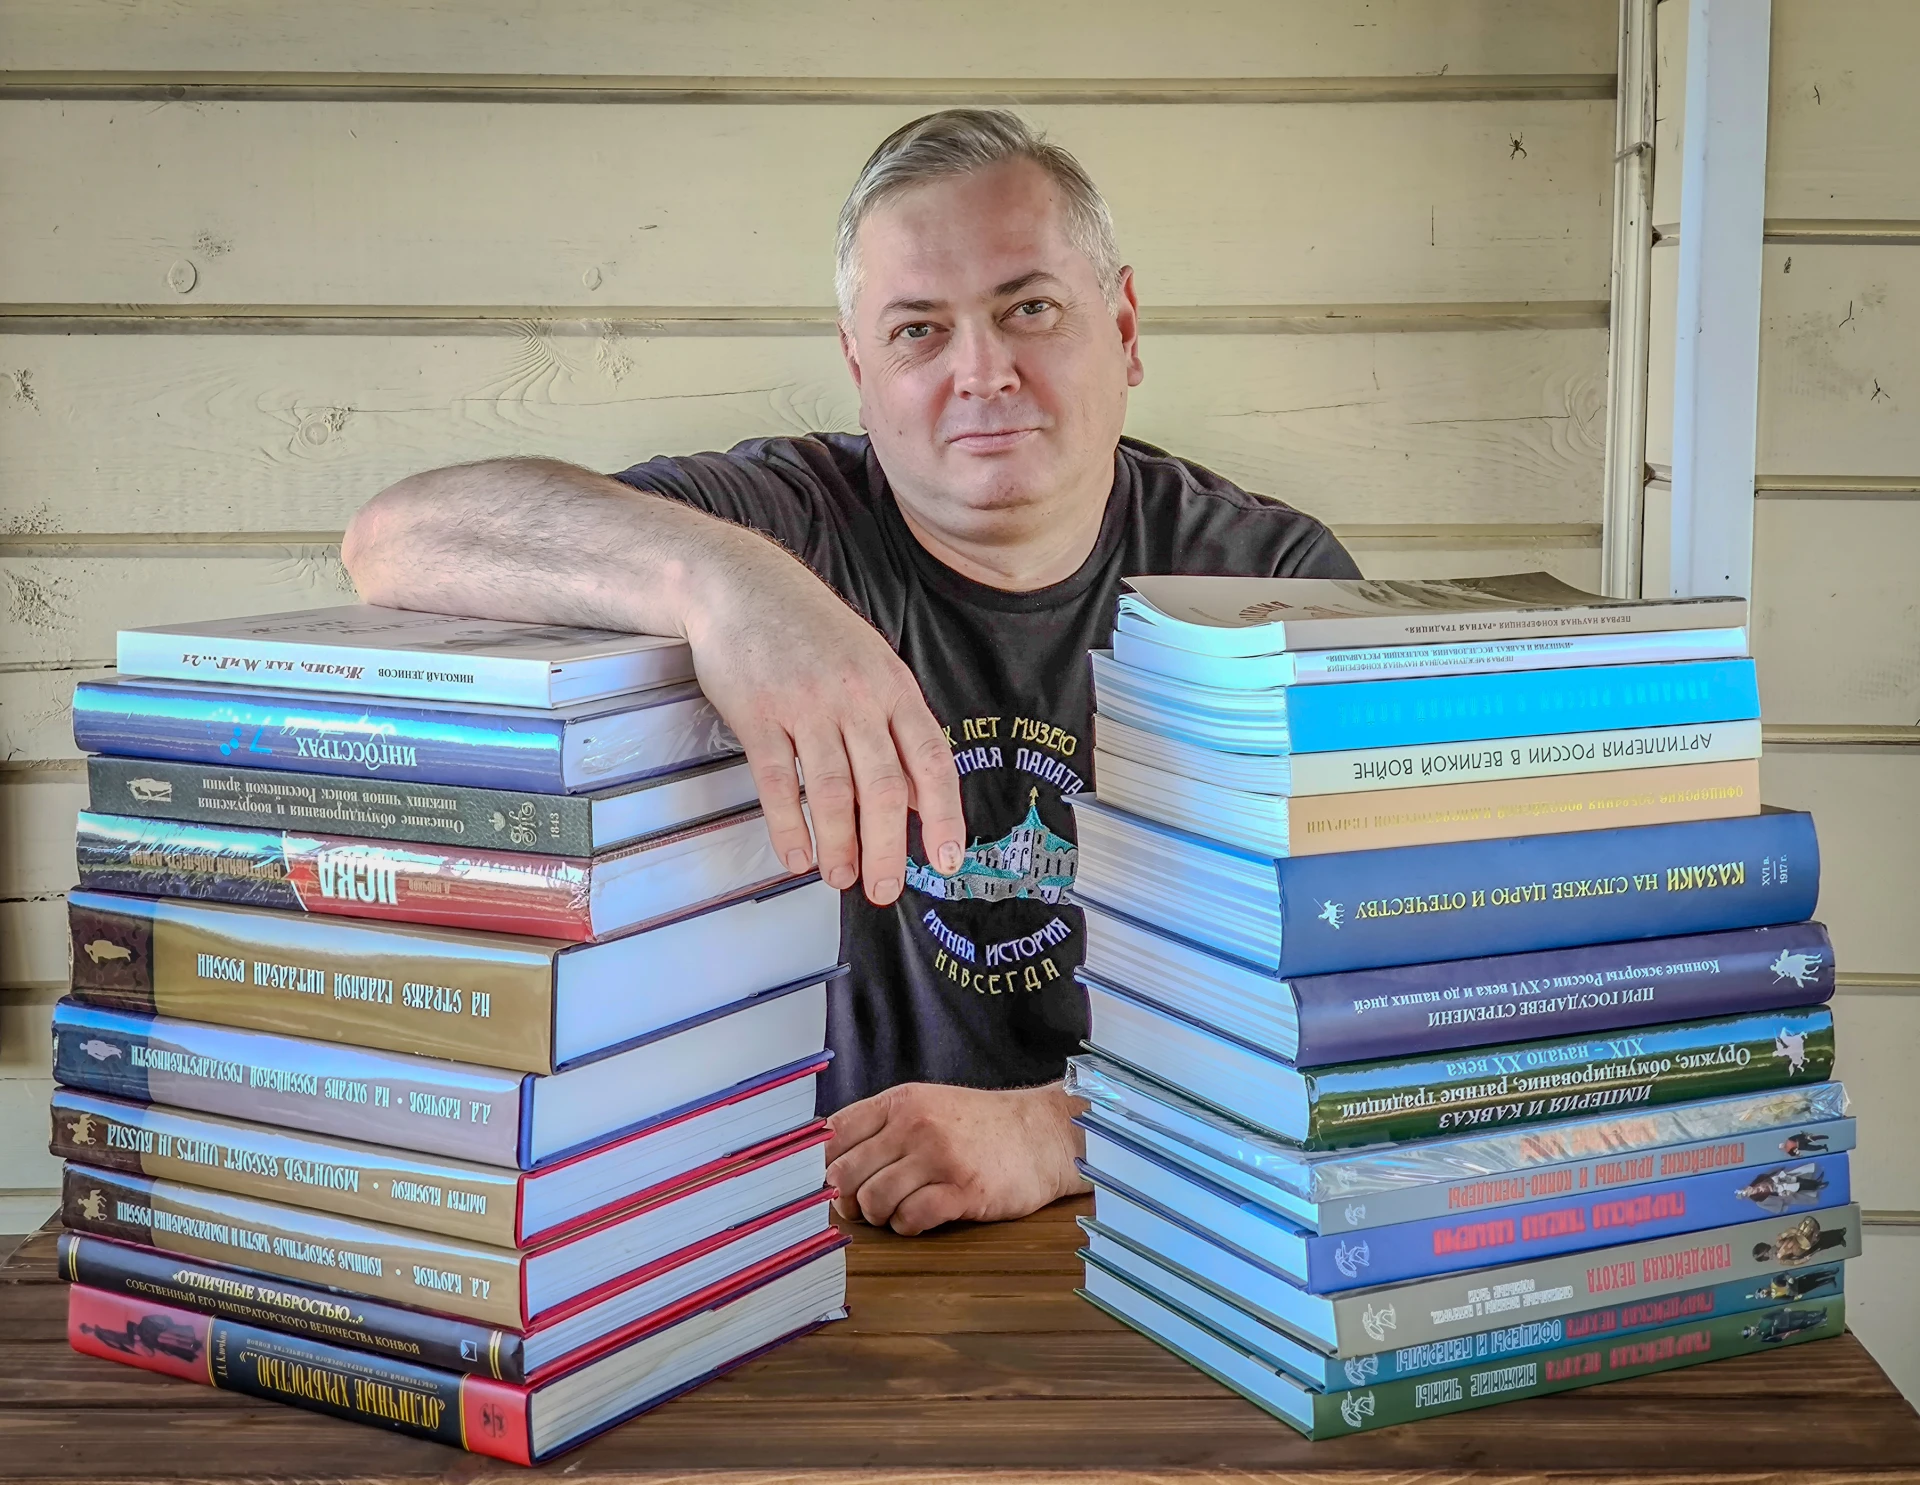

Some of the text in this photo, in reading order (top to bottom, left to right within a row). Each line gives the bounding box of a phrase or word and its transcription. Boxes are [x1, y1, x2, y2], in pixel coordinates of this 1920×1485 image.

[1404, 615, 1630, 633] ПЕРВАЯ НАУЧНАЯ КОНФЕРЕНЦИЯ «РАТНАЯ ТРАДИЦИЯ»
[264, 659, 294, 671] как
[1325, 651, 1380, 662] РЕСТАВРАЦИЯ»
[1326, 655, 1513, 672] ПЕРВАЯ МЕЖДУНАРОДНАЯ НАУЧНАЯ КОНФЕРЕНЦИЯ
[1533, 641, 1573, 650] «ИМПЕРИЯ
[301, 660, 365, 679] Жизнь,
[377, 668, 474, 683] НИКОЛАЙ ДЕНИСОВ
[295, 736, 417, 769] ИНГОССТРАХ
[1010, 716, 1077, 756] МУЗЕЮ
[1352, 732, 1711, 780] АРТИЛЛЕРИЯ РОССИИ В ВЕЛИКОЙ ВОЙНЕ
[1016, 747, 1084, 794] ПАЛАТА
[201, 776, 457, 811] нижних чинов войск Российской армии
[197, 795, 464, 834] Описание обмундирования и вооружения
[549, 812, 560, 838] 1843
[165, 854, 214, 873] ДОБЛЕСТЬ
[216, 856, 280, 880] СПОРТИВНАЯ
[317, 852, 398, 905] ЦСКА
[1761, 855, 1770, 885] XVI в.
[1779, 853, 1787, 884] 1917 г.
[1354, 860, 1745, 919] КАЗАКИ НА СЛУЖБЕ ЦАРЮ И ОТЕЧЕСТВУ
[922, 908, 1072, 966] РАТНАЯ ИСТОРИЯ
[196, 952, 490, 1017] НА СТРАЖЕ ГЛАВНОЙ ЦИТАДЕЛИ РОССИИ
[934, 948, 1061, 994] НАВСЕГДА
[1352, 959, 1720, 1013] Конные эскорты России с XVI века и до наших дней
[1426, 986, 1654, 1026] ПРИ ГОСУДАРЕВЕ СТРЕМЕНИ
[1445, 1037, 1644, 1076] XIX начало XX века
[130, 1044, 491, 1124] Д.А. КЛОЧКОВ НА ОХРАНЕ РОССИЙСКОЙ ГОСУДАРСТВЕННОСТИ
[1336, 1043, 1750, 1118] Оружие, обмундирование, ратные традиции.
[1438, 1084, 1652, 1128] ИМПЕРИЯ И КАВКАЗ
[1448, 1141, 1744, 1208] ГВАРДЕЙСКИЕ ДРАГУНЫ И КОННО-ГРЕНАДЕРЫ
[1591, 1190, 1684, 1230] ГВАРДЕЙСКАЯ
[116, 1201, 490, 1299] Д.А. КЛОЧКОВ КОННЫЕ ЭСКОРТНЫЕ ЧАСТИ И ПОДРАЗДЕЛЕНИЯ РОССИИ
[1432, 1218, 1514, 1256] КАВАЛЕРИЯ
[172, 1270, 255, 1300] «ОТЛИЧНЫЕ
[1585, 1243, 1731, 1293] ГВАРДЕЙСКАЯ ПЕХОТА
[126, 1278, 421, 1354] СОБСТВЕННЫЙ ЕГО ИМПЕРАТОРСКОГО ВЕЛИЧЕСТВА КОНВОЙ
[1396, 1291, 1713, 1372] ГВАРДЕЙСКАЯ ПЕХОТА ОФИЦЕРЫ И ГЕНЕРАЛЫ
[246, 1338, 437, 1389] СОБСТВЕННЫЙ ЕГО ИМПЕРАТОРСКОГО ВЕЛИЧЕСТВА КОНВОЙ
[1415, 1330, 1710, 1407] ГВАРДЕЙСКАЯ ПЕХОТА НИЖНИЕ ЧИНЫ
[354, 1378, 445, 1429] «ОТЛИЧНЫЕ
